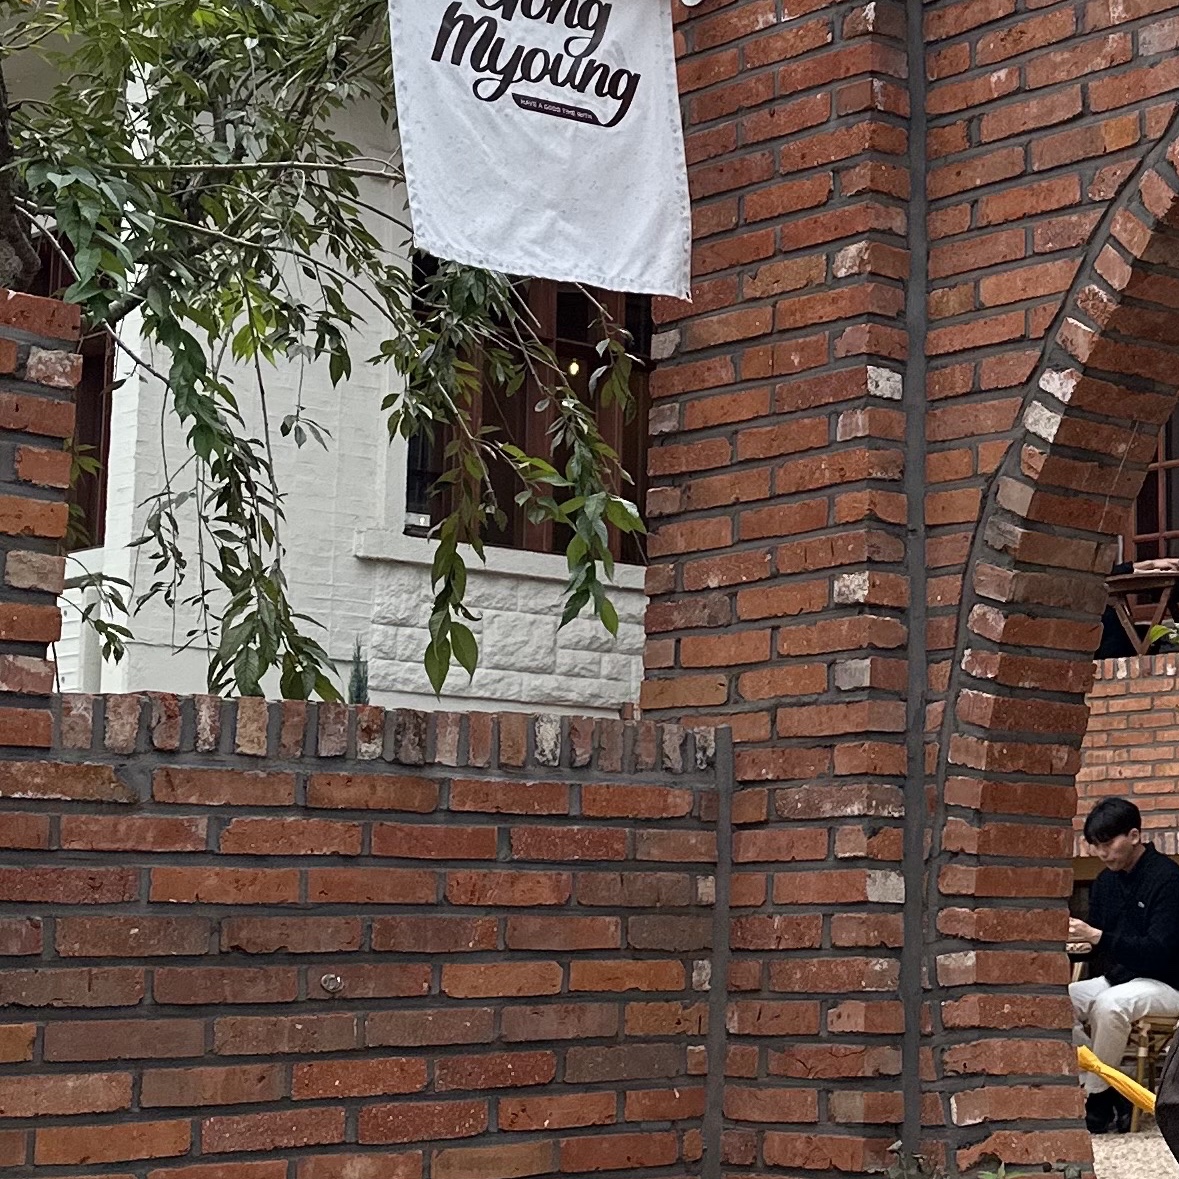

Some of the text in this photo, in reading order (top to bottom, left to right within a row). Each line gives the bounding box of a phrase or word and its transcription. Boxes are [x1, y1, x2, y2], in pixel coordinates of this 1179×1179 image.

[431, 1, 641, 127] Myoung
[520, 99, 537, 108] HAVE
[544, 104, 561, 113] GOOD
